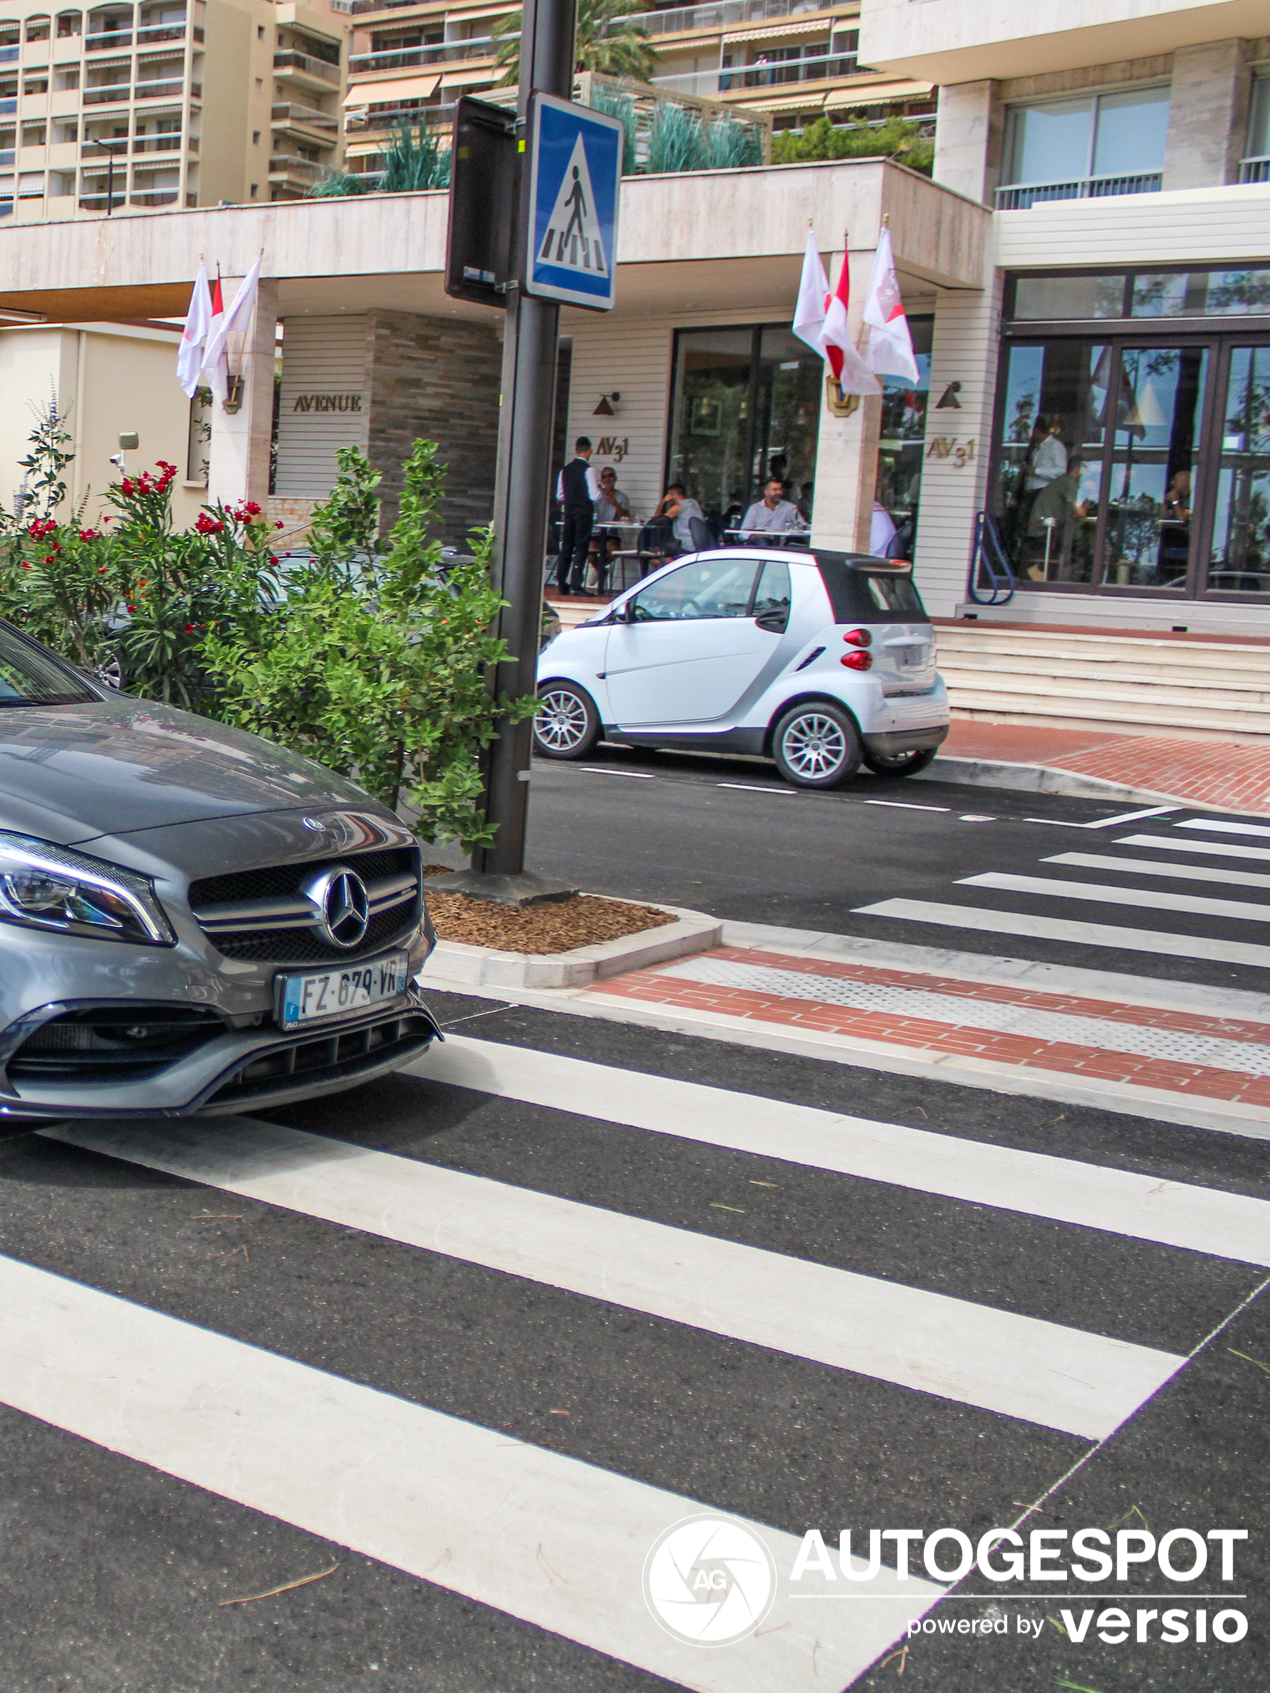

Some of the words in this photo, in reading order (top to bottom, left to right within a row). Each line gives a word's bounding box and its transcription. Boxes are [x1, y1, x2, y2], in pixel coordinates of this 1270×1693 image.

[293, 395, 362, 412] AVENUE
[596, 436, 629, 464] AV31
[925, 437, 975, 469] AV31
